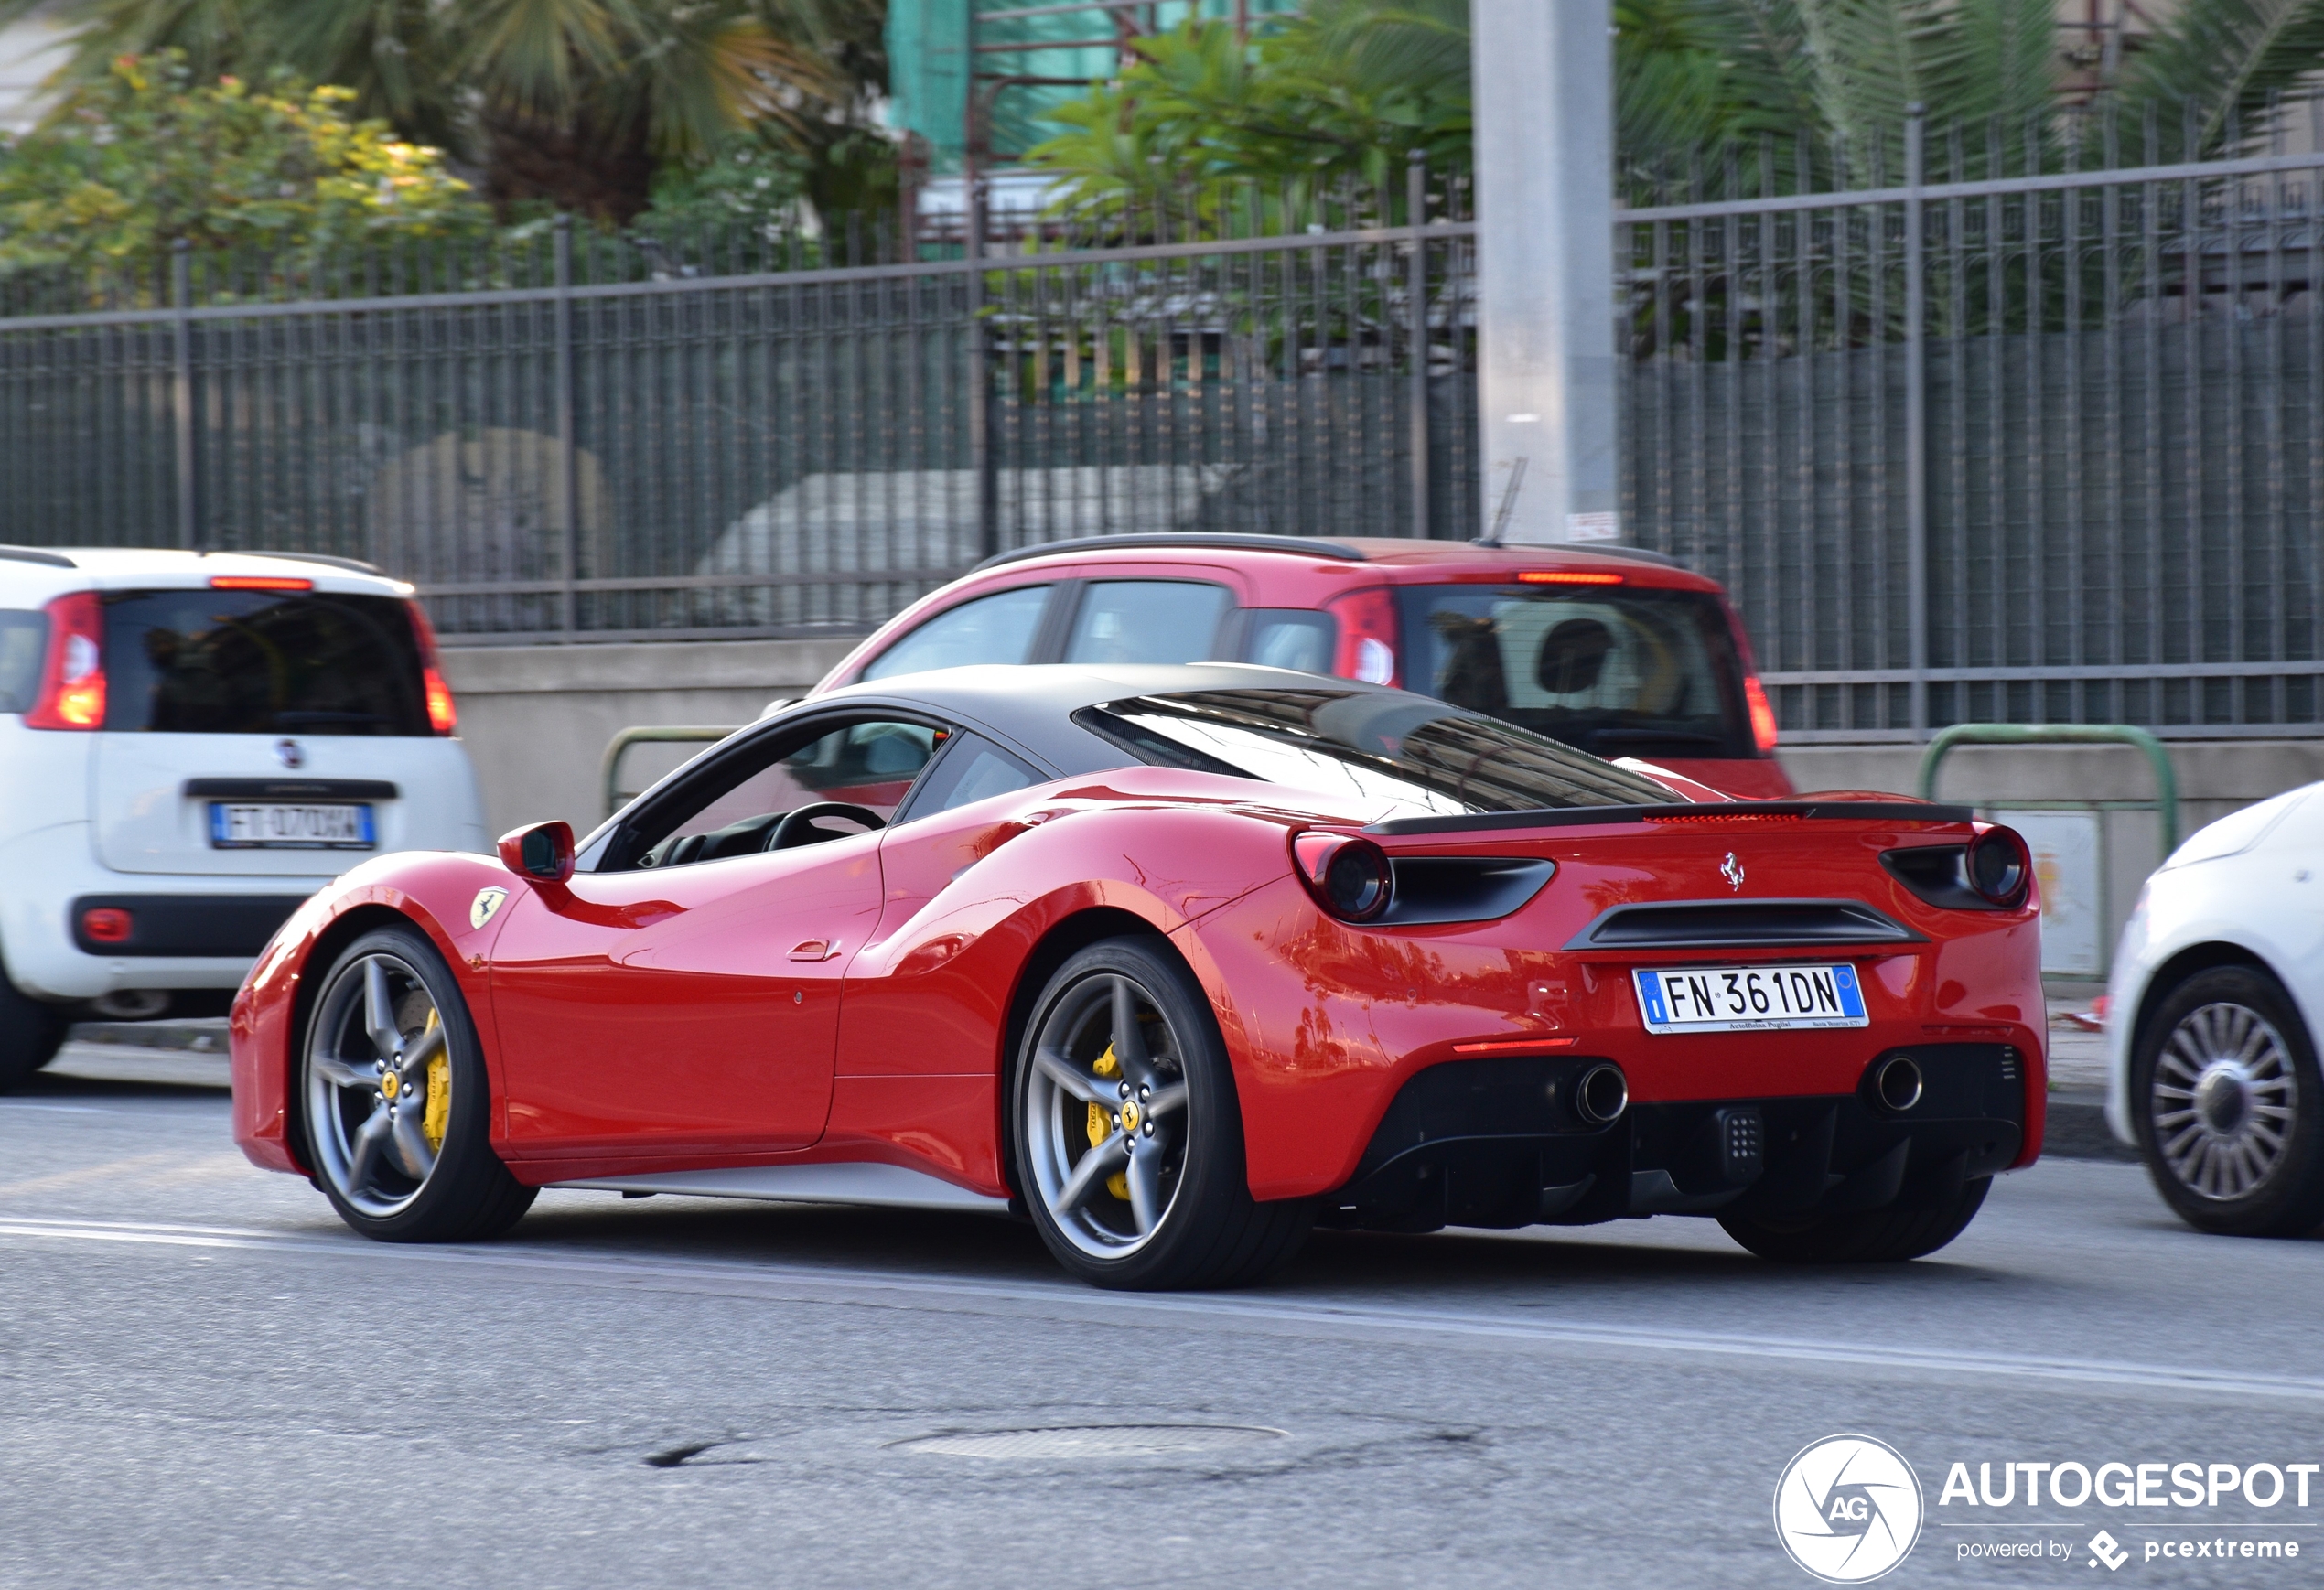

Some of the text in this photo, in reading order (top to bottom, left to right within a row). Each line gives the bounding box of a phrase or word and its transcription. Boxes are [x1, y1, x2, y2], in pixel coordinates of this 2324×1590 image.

[1664, 971, 1839, 1018] FN 361DN
[1768, 1020, 1791, 1029] Puglisi
